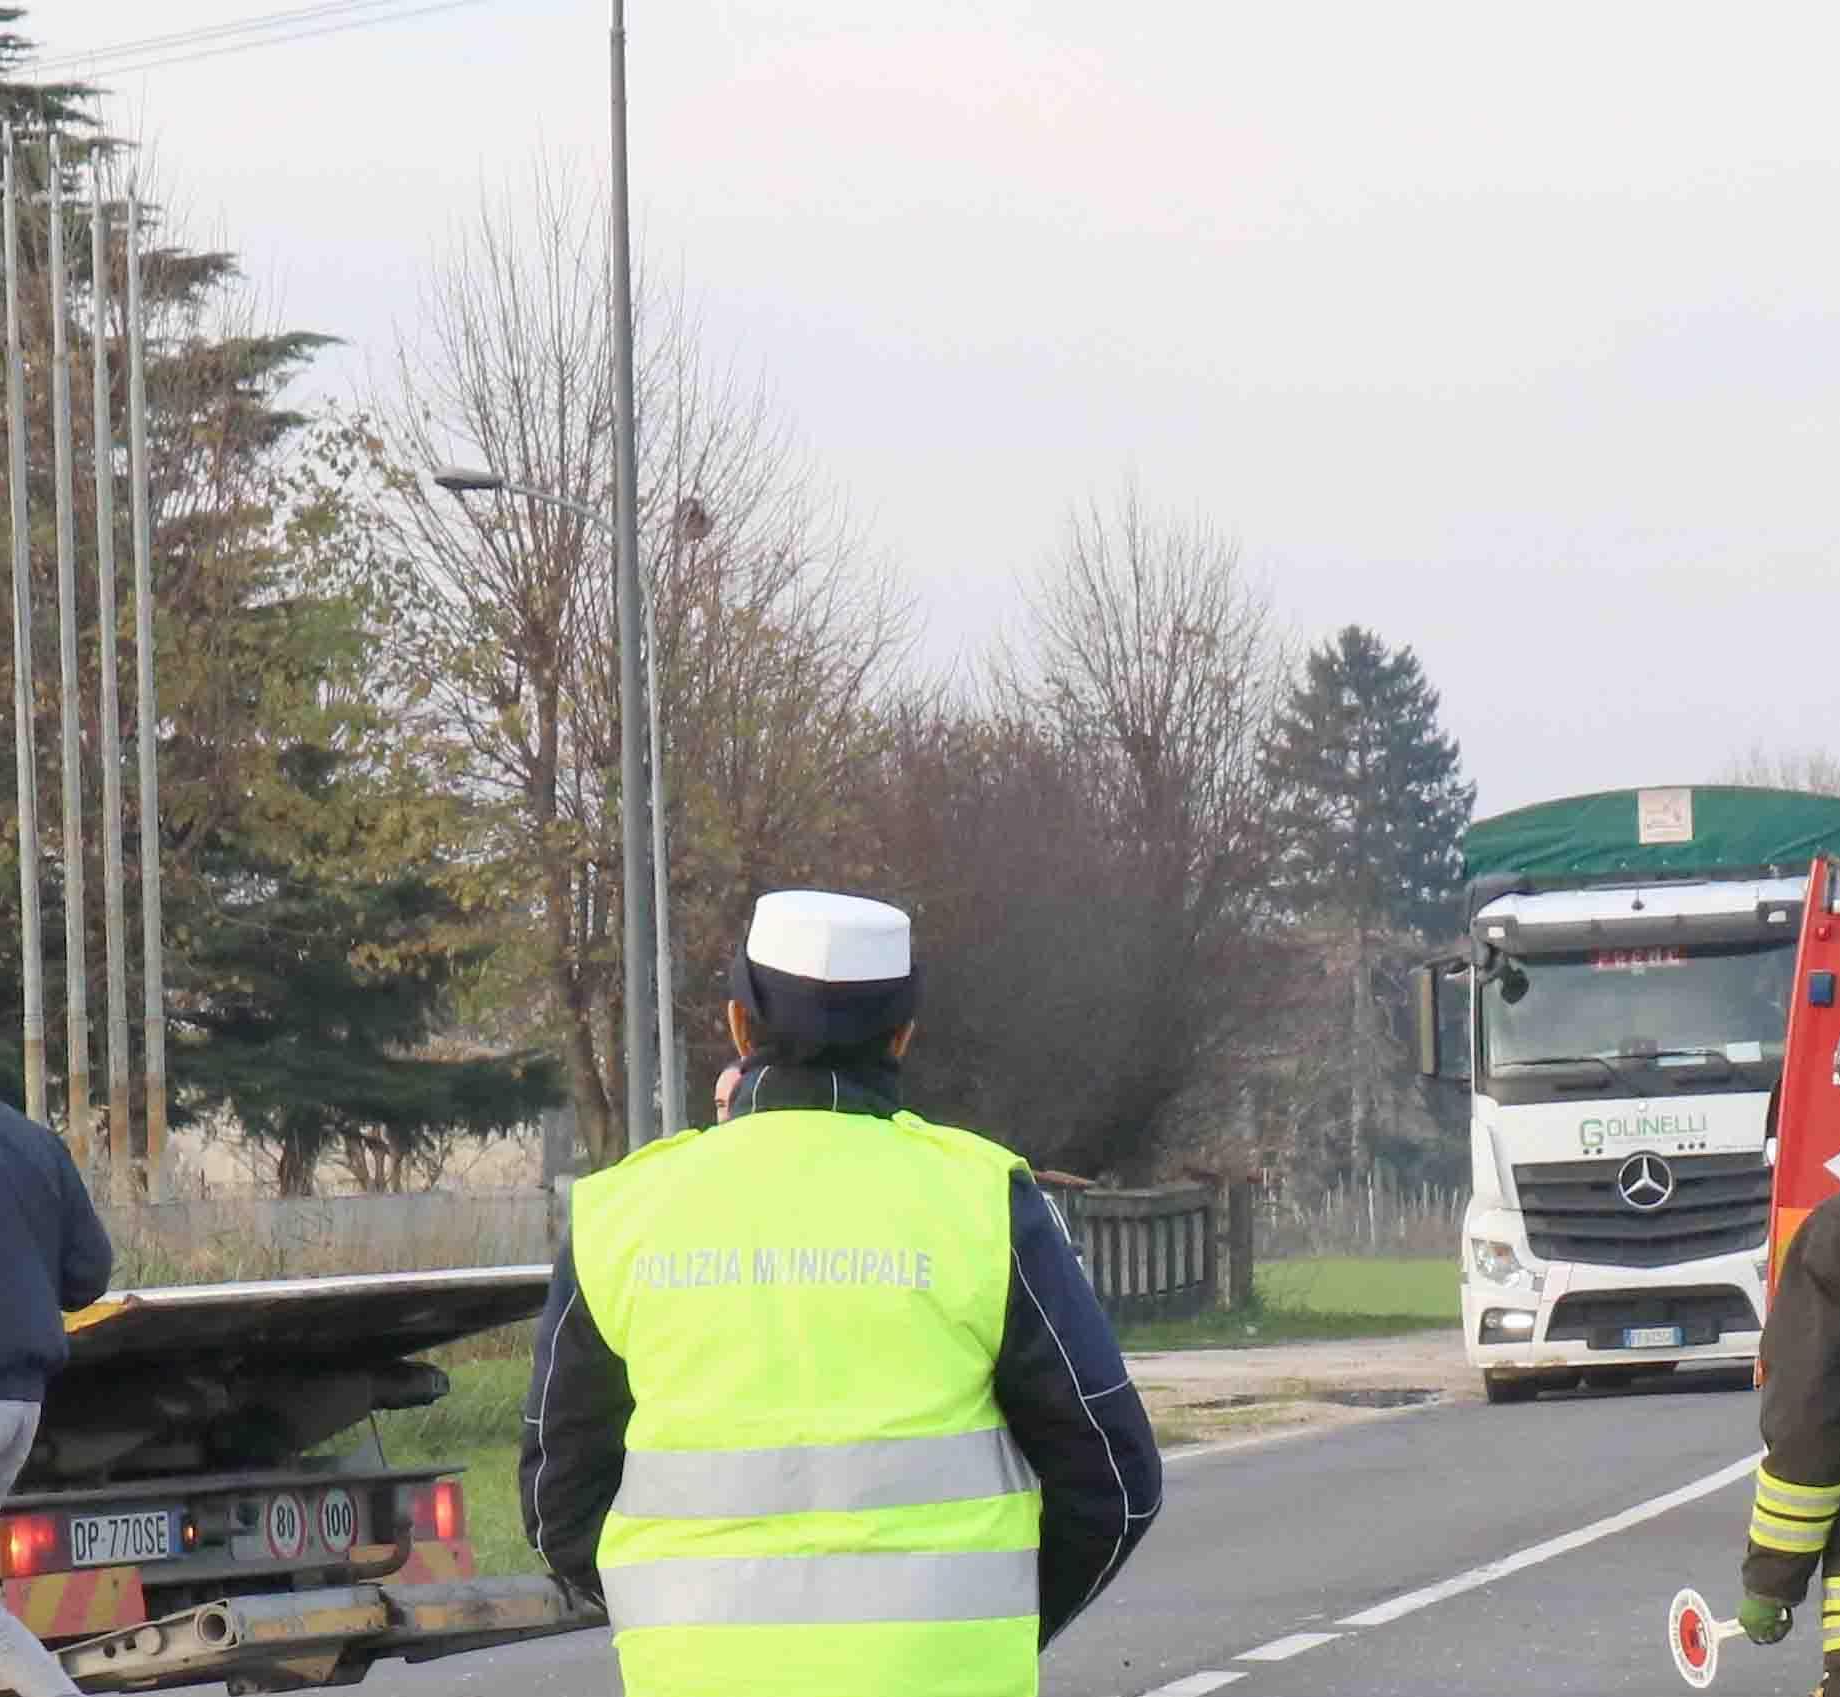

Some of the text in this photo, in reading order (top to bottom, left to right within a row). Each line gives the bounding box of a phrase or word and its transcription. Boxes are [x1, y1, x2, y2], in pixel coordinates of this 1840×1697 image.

[1580, 1113, 1708, 1147] GOLINELLI
[634, 1247, 932, 1289] POLIZIA MNICIPALE
[275, 1507, 295, 1539] 80
[324, 1501, 352, 1536] 100
